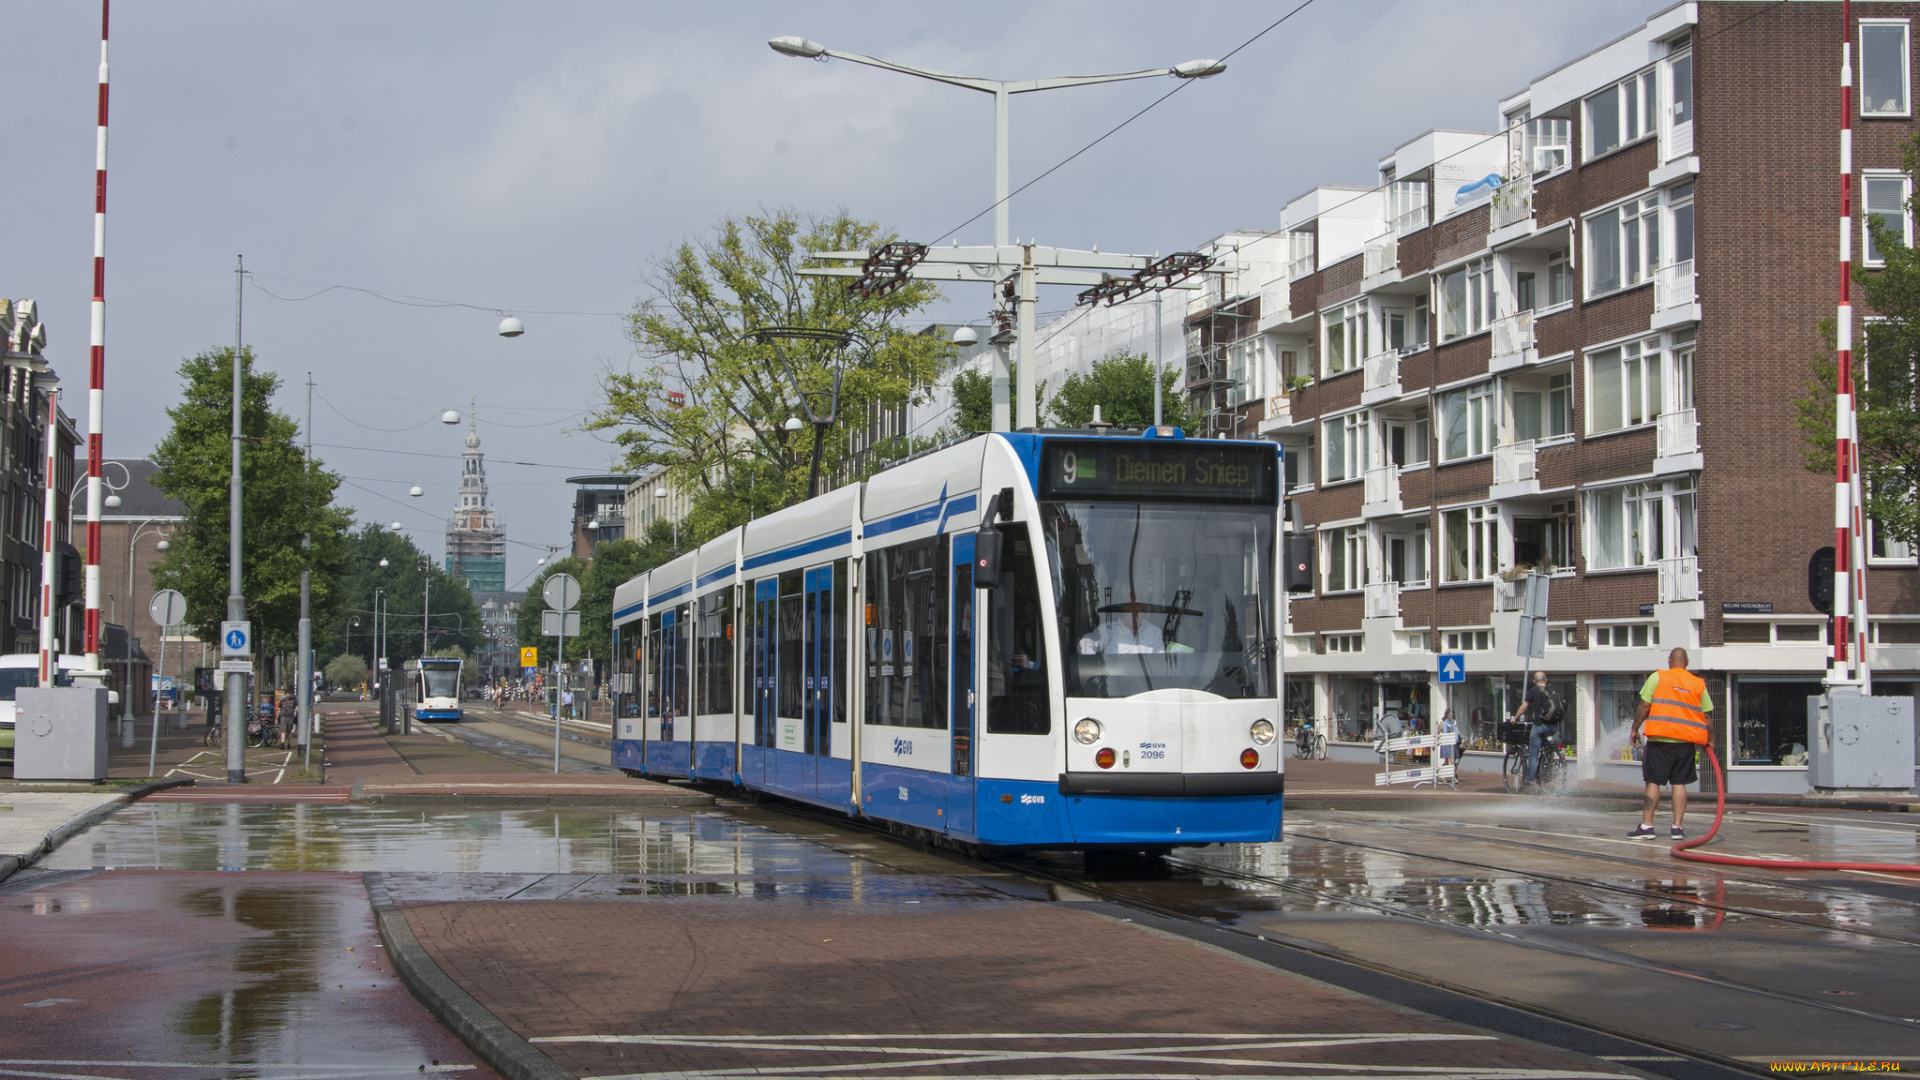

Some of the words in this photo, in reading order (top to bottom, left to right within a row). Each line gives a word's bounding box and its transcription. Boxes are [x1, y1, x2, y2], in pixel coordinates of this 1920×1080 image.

[1063, 451, 1077, 484] 9
[1116, 454, 1185, 483] Diemen
[1195, 457, 1249, 488] Sniep
[903, 739, 913, 755] GVB
[1140, 750, 1165, 759] 2096
[898, 786, 909, 801] 2096
[1032, 795, 1045, 804] GVB
